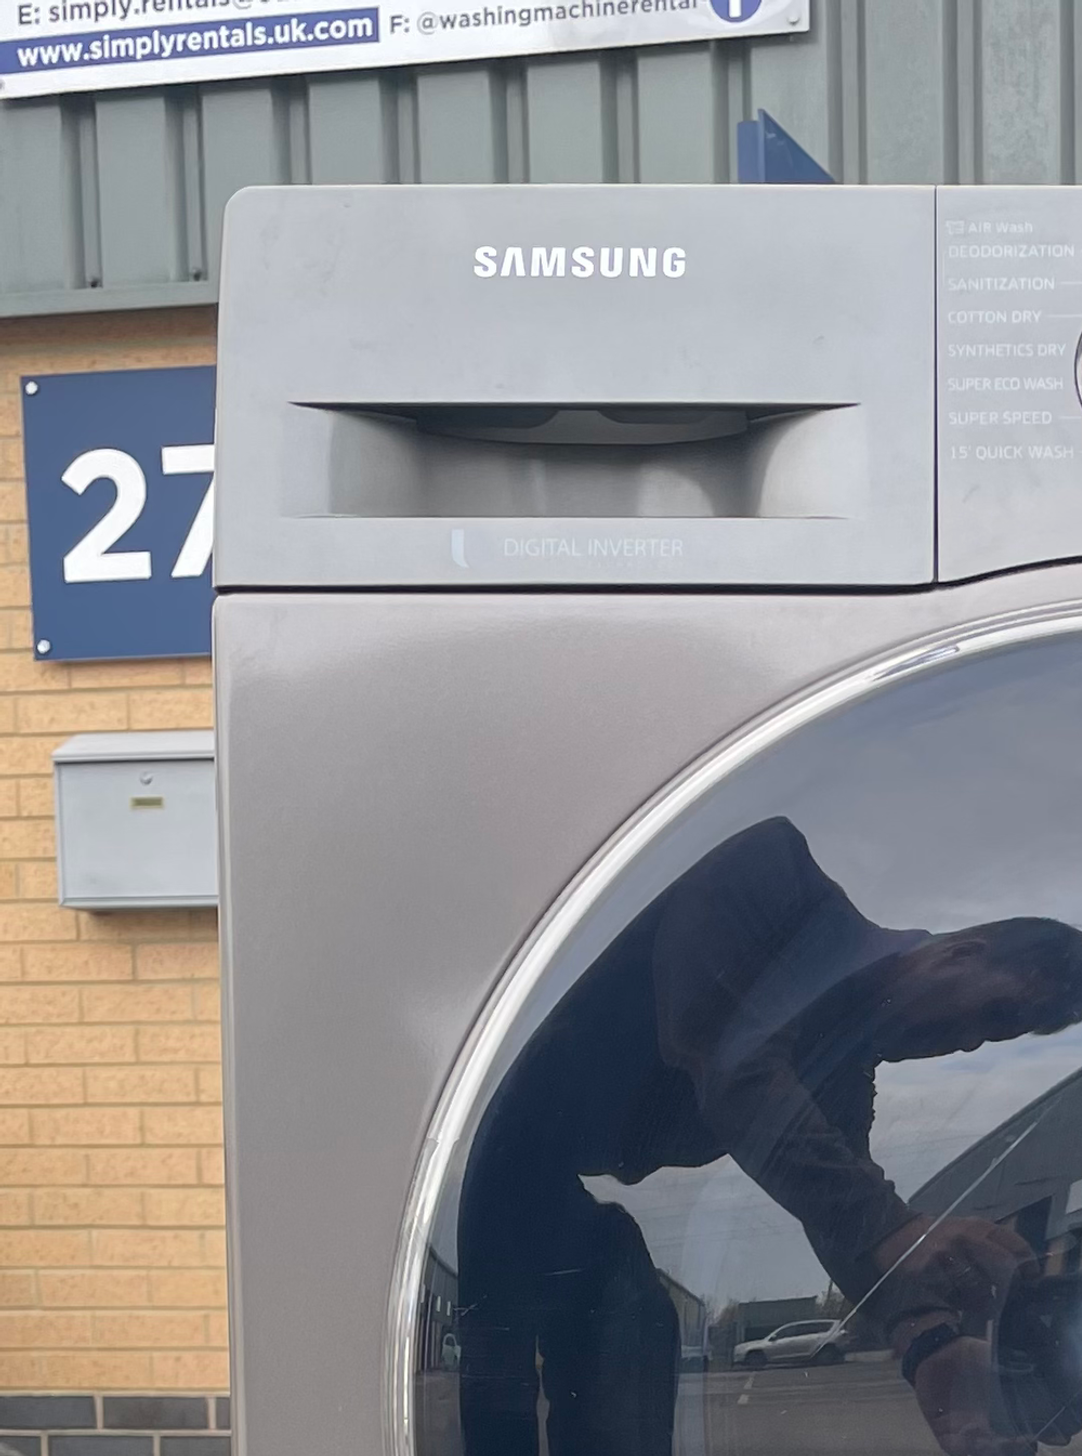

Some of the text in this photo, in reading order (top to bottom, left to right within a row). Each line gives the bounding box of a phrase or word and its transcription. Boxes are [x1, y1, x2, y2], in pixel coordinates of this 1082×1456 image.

[18, 5, 41, 25] E:
[389, 15, 410, 34] F:
[17, 15, 373, 67] www.simplyrentals.uk.com
[968, 221, 1034, 234] AIR Wash
[948, 244, 1075, 258] DEODORIZATION
[473, 245, 687, 278] SAMSUNG
[948, 277, 1055, 291] SANITIZATION
[947, 310, 1042, 324] COTTON DRY
[948, 343, 1067, 357] SYNTHETICS DRY
[948, 377, 1064, 391] SUPER ECO WASH
[948, 411, 1053, 425] SUPER SPEED
[975, 445, 1023, 461] QUICK
[1028, 446, 1075, 460] WASH
[61, 444, 215, 583] 27
[504, 538, 683, 557] DIGITAL INVERTER
